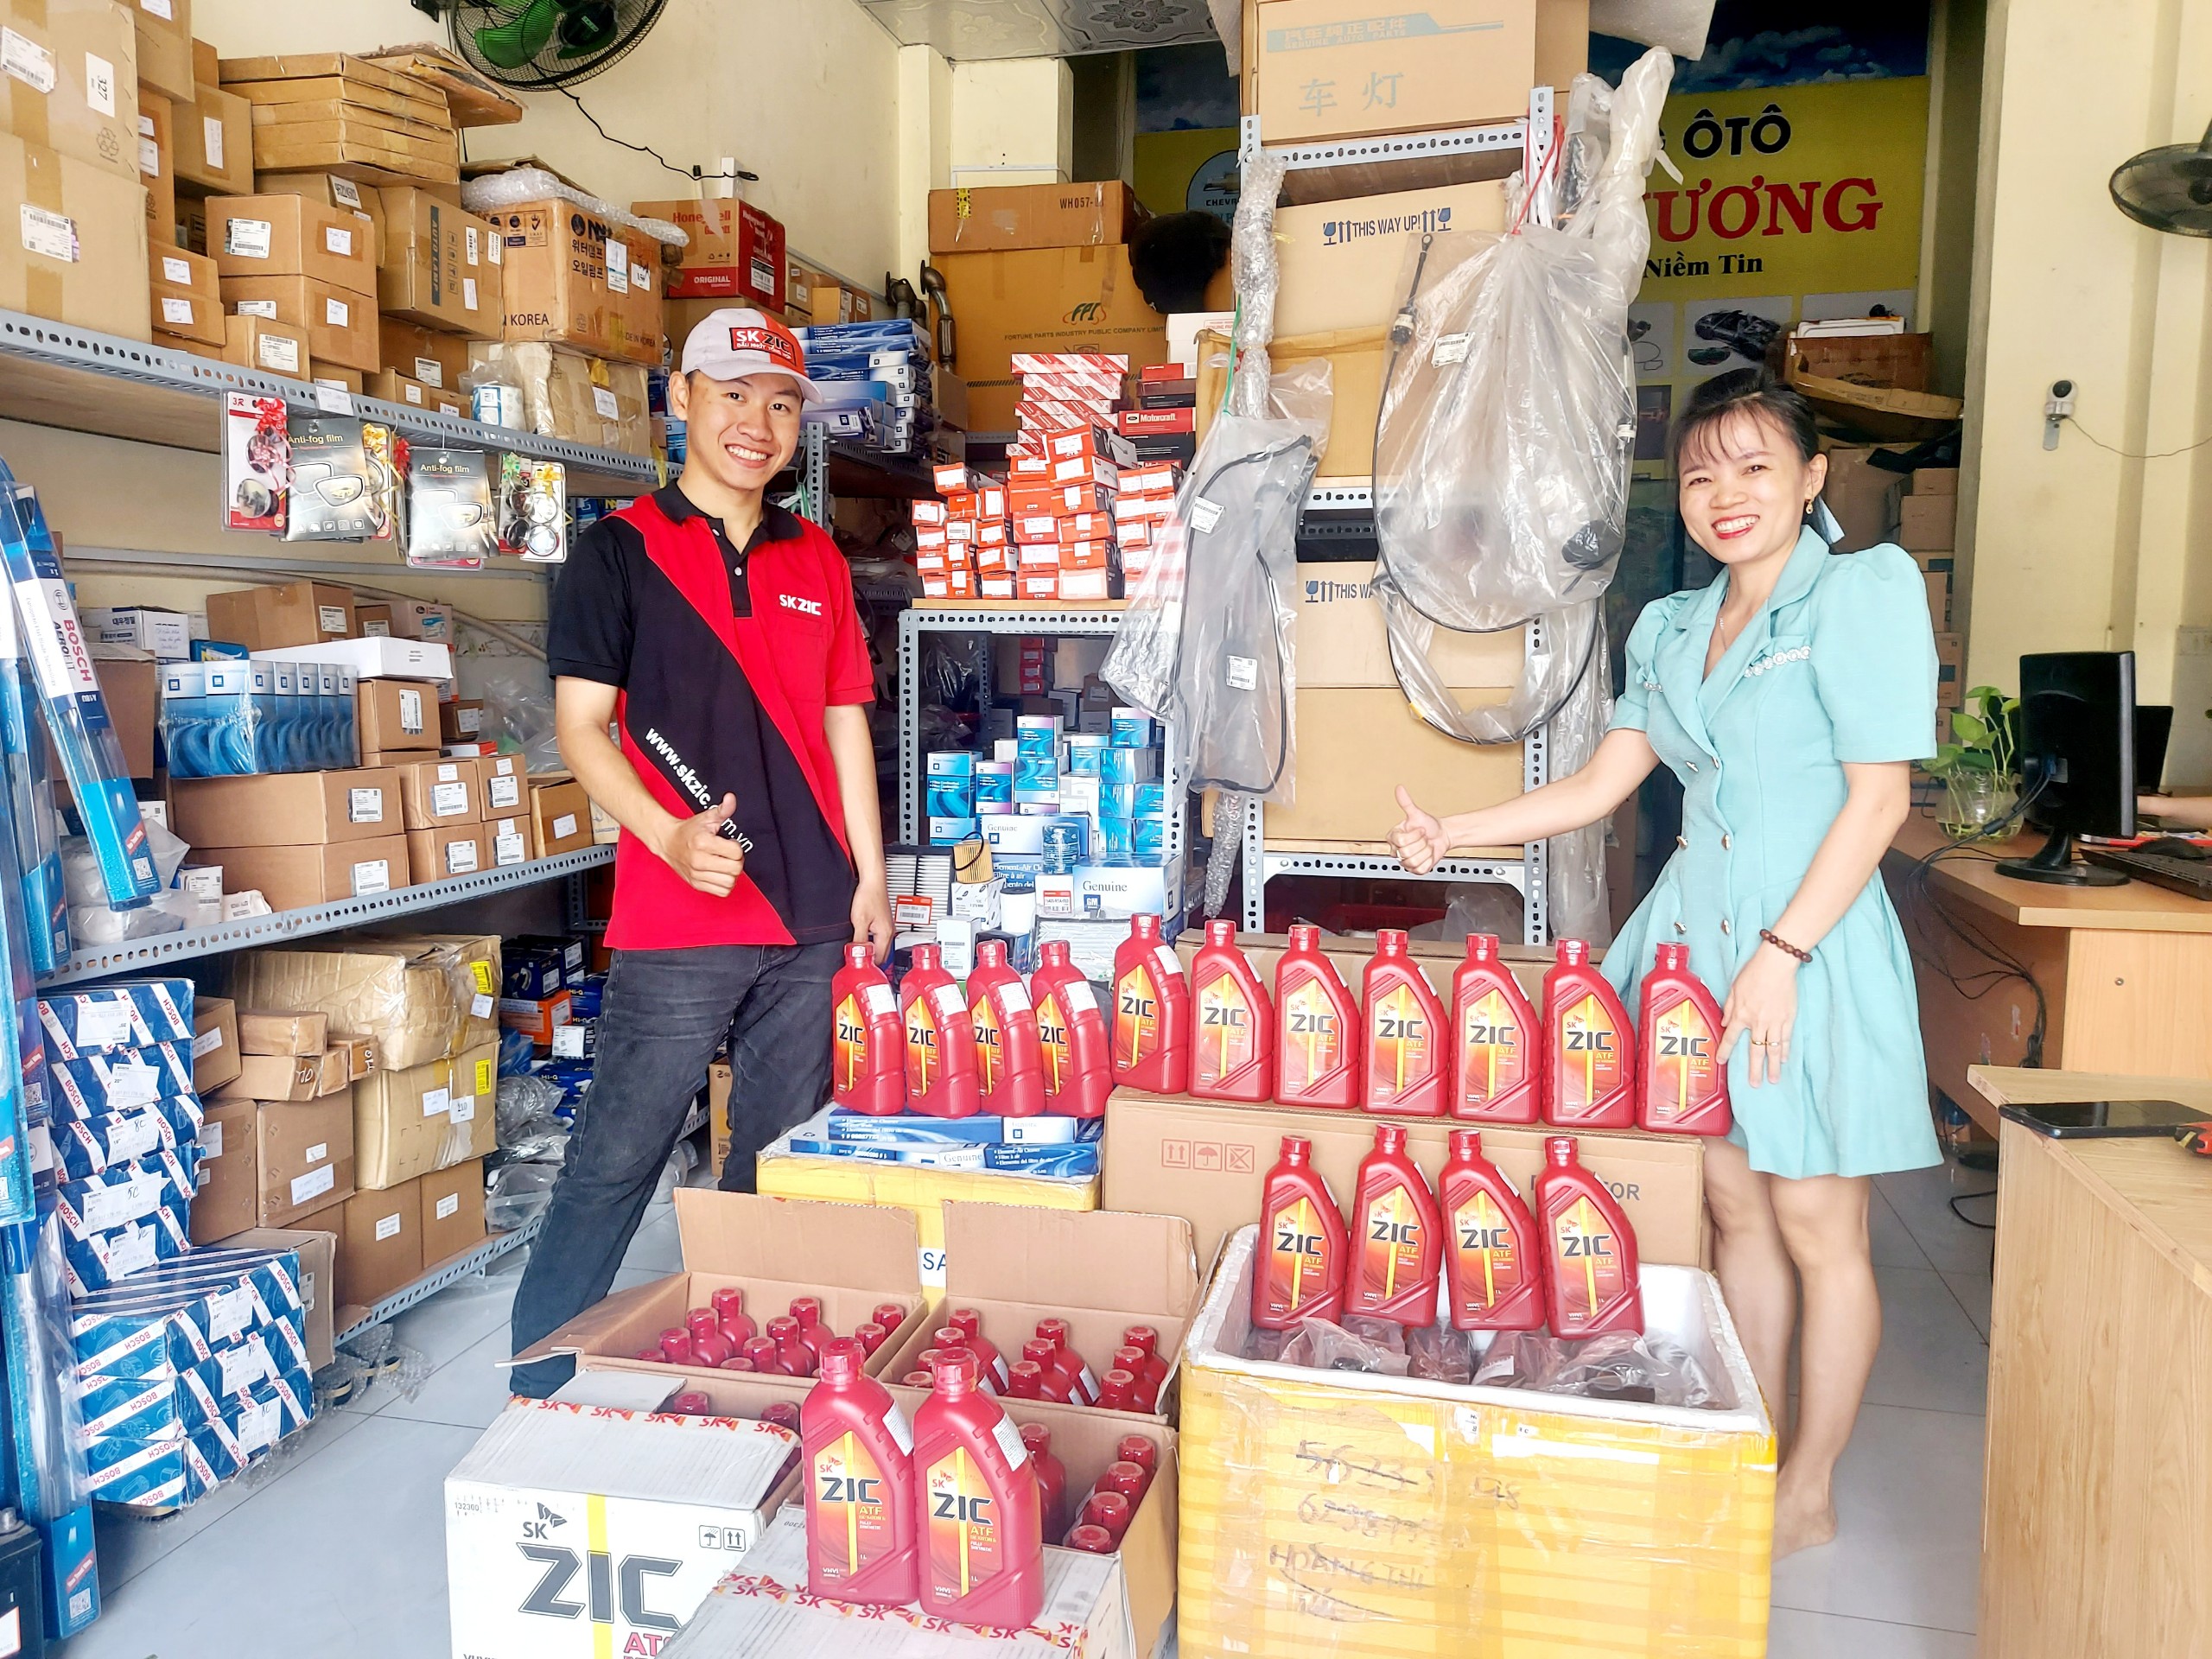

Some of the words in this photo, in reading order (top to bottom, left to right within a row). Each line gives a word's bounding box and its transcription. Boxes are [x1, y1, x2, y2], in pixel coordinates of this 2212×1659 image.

[1335, 34, 1364, 42] AUTO
[1372, 29, 1406, 39] PARTS
[98, 75, 108, 100] 327
[1299, 72, 1405, 117] 车灯
[1682, 103, 1791, 159] ÔTÔ
[1059, 197, 1104, 209] WH057-
[1205, 198, 1238, 207] CHEVR
[1642, 174, 1884, 243] ƯƠNG
[673, 210, 731, 225] Honeell
[1352, 219, 1376, 238] THIS
[1377, 215, 1402, 235] WAY
[1404, 213, 1421, 232] UP!
[431, 219, 440, 252] AUTO
[1643, 251, 1710, 279] Niềm
[1719, 253, 1764, 275] Tin
[694, 275, 731, 284] ORIGINAL
[510, 313, 550, 327] KOREA
[1055, 329, 1087, 339] INDUSTRY
[1089, 327, 1112, 336] PUBLIC
[1113, 326, 1146, 335] COMPANY
[1147, 325, 1165, 334] LIMIT
[736, 330, 760, 343] SK
[762, 332, 791, 356] ZIC
[1140, 412, 1177, 423] Motorcraft
[288, 434, 324, 445] Anti-fog
[326, 434, 343, 442] film
[420, 463, 453, 474] Anti-fog
[454, 465, 470, 474] film
[1334, 582, 1358, 600] THIS
[1359, 582, 1375, 599] WA
[779, 594, 798, 609] SK
[797, 597, 823, 616] ZIC
[53, 620, 76, 671] AEROFIT
[63, 620, 92, 682] BOSCH
[645, 728, 753, 854] www.skzic.m.vn
[1082, 880, 1128, 893] Genuine
[1086, 897, 1098, 906] GM
[163, 998, 180, 1026] BOSCH
[1121, 995, 1154, 1019] ZIC
[1204, 1007, 1246, 1027] ZIC
[839, 1022, 864, 1045] ZIC
[1229, 1027, 1247, 1036] ATF
[1290, 1014, 1334, 1033] ZIC
[1378, 1019, 1424, 1039] ZIC
[1660, 1026, 1672, 1034] SK
[909, 1027, 936, 1047] ZIC
[975, 1026, 1000, 1046] ZIC
[1039, 1025, 1067, 1046] ZIC
[1469, 1025, 1516, 1046] ZIC
[1566, 1031, 1614, 1051] ZIC
[1660, 1036, 1710, 1058] ZIC
[65, 1079, 83, 1108] BOSCH
[74, 1122, 92, 1145] OSCH
[156, 1116, 173, 1143] BOSCH
[944, 1153, 983, 1163] Genuine
[59, 1201, 79, 1230] BOSCH
[1370, 1220, 1420, 1245] ZIC
[1460, 1228, 1510, 1249] ZIC
[1276, 1231, 1323, 1255] ZIC
[1561, 1235, 1613, 1256] ZIC
[276, 1268, 293, 1294] BOSCH
[124, 1332, 151, 1351] BOSCH
[283, 1323, 299, 1348] BOSCH
[195, 1338, 210, 1360] BOSC
[79, 1358, 102, 1376] BOSC
[130, 1391, 158, 1412] BOSCH
[204, 1396, 219, 1418] BOSC
[537, 1400, 560, 1412] SK
[590, 1407, 611, 1418] SK
[644, 1412, 667, 1424] SK
[698, 1416, 721, 1428] SK
[85, 1421, 105, 1437] BOSC
[753, 1422, 776, 1434] SK
[93, 1466, 121, 1485] BOSCH
[194, 1456, 212, 1482] BOSCH
[820, 1464, 833, 1473] SK
[820, 1476, 882, 1504] ZIC
[932, 1478, 945, 1488] SK
[138, 1490, 164, 1506] BOSC
[859, 1506, 883, 1515] ATF
[933, 1492, 993, 1525] ZIC
[523, 1522, 550, 1540] SK
[970, 1526, 994, 1535] ATF
[516, 1541, 683, 1633] ZIC
[733, 1584, 760, 1598] SK
[794, 1593, 824, 1609] SK
[857, 1606, 888, 1621] SK
[923, 1618, 953, 1633] SK
[988, 1626, 1020, 1640] SK
[623, 1632, 671, 1657] AT
